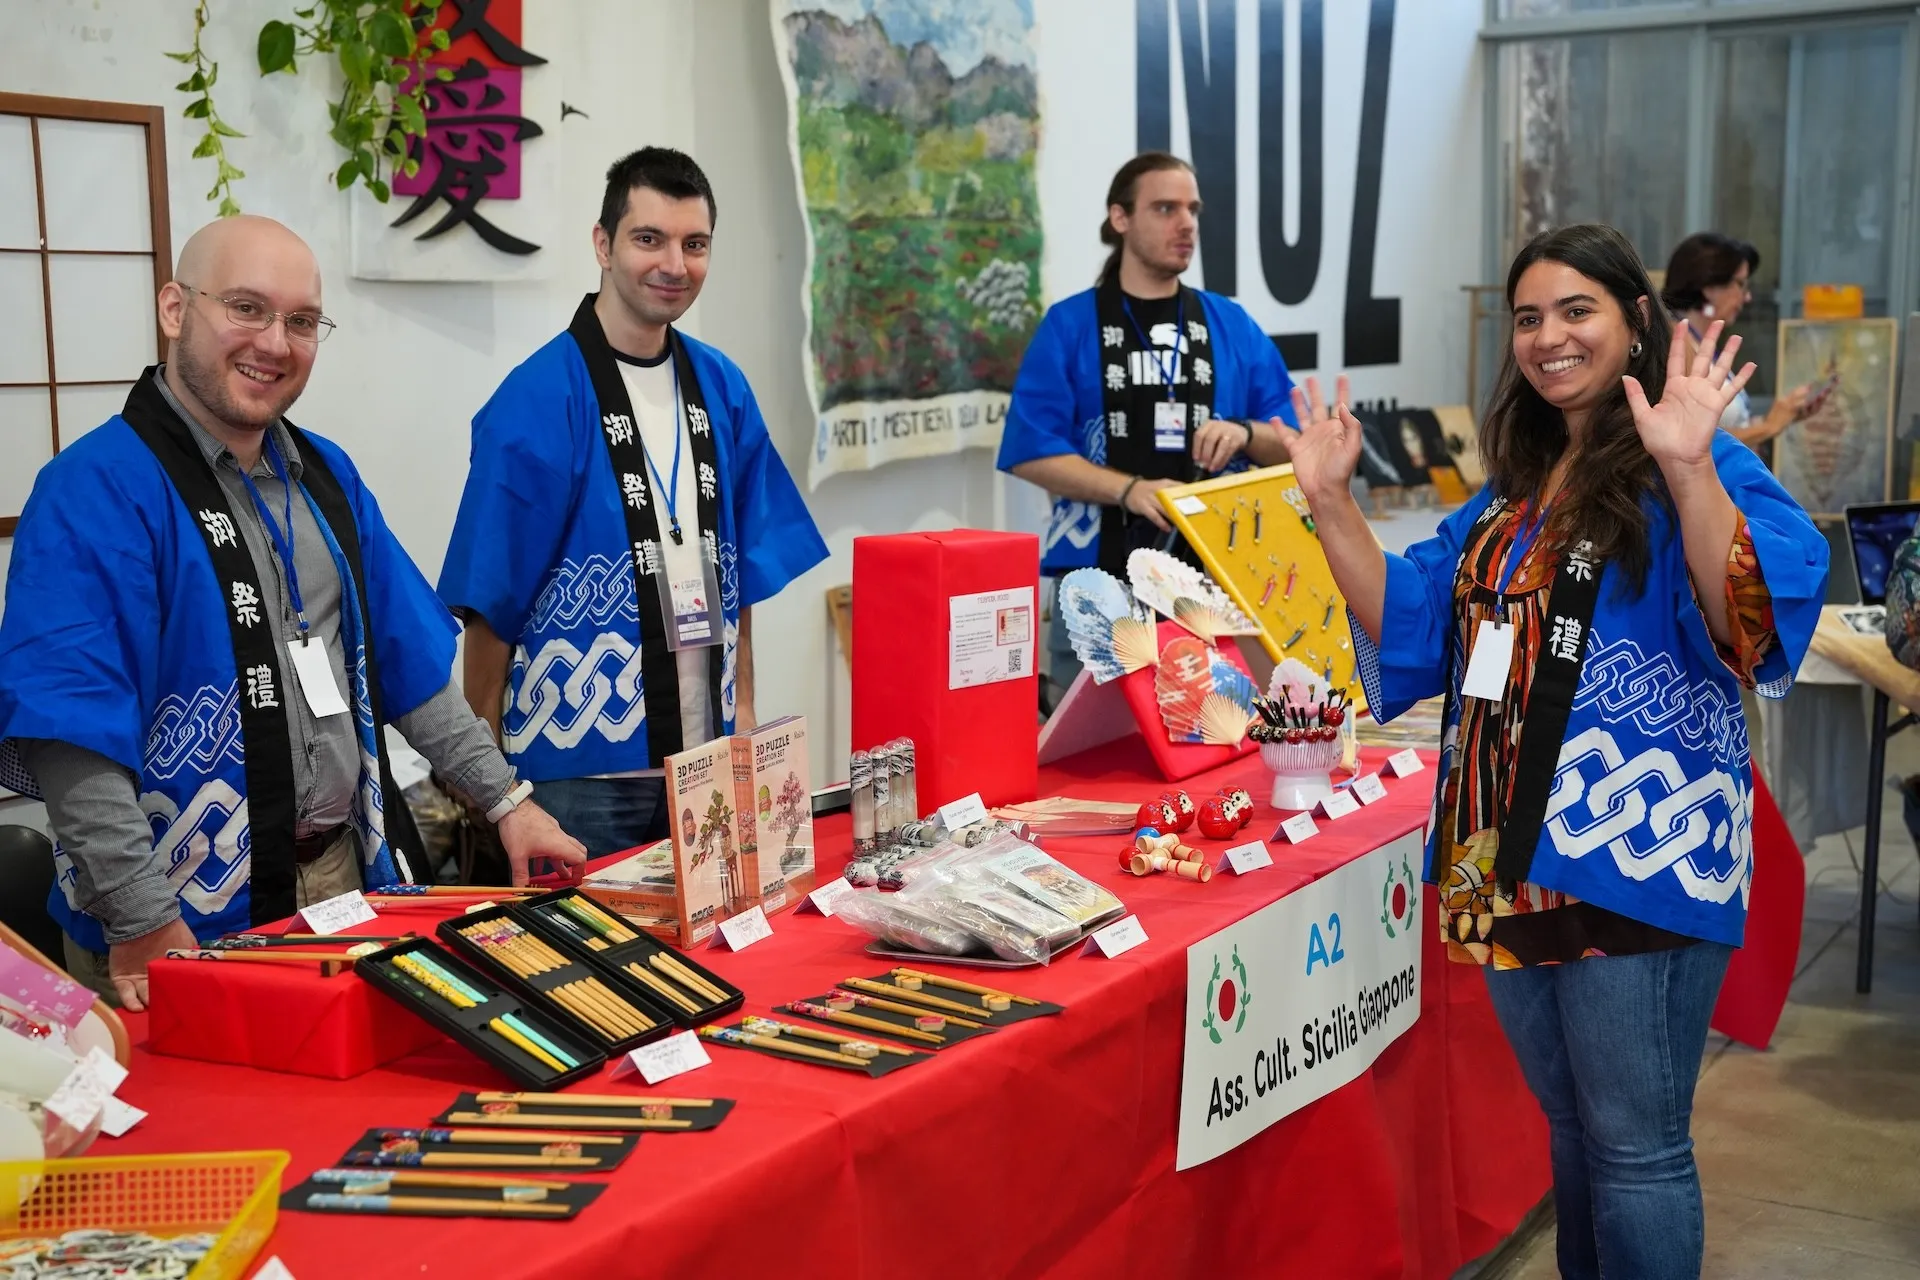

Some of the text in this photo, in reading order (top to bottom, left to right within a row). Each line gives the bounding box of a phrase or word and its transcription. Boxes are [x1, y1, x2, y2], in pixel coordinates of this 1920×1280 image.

[832, 420, 867, 447] ARTI
[756, 734, 790, 757] 3D PUZZLE
[756, 749, 785, 765] CREATION SET
[677, 755, 713, 778] 3D PUZZLE
[678, 770, 708, 788] CREATION SET
[1306, 912, 1345, 976] A2
[1205, 963, 1415, 1128] Ass. Cult. Sicilia Giappone
